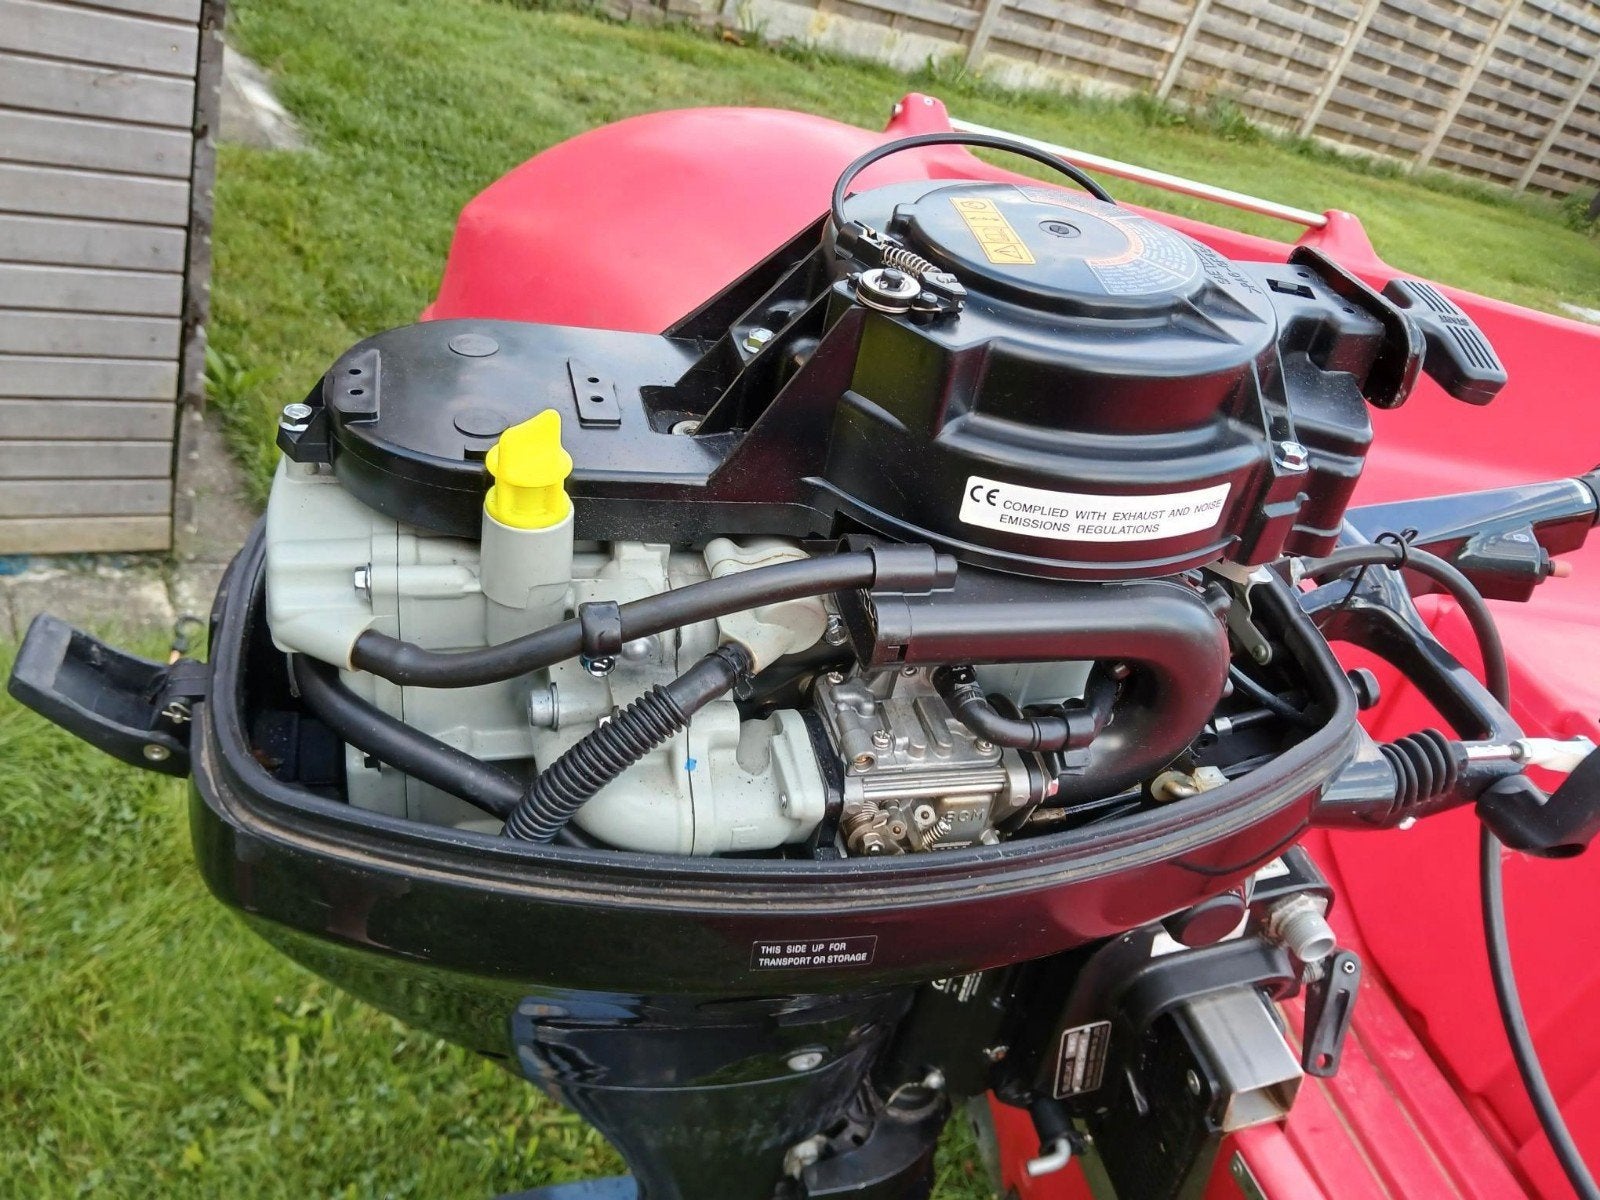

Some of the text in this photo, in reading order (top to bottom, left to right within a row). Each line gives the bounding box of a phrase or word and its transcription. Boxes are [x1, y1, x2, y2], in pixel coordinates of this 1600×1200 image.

[970, 485, 1000, 506] CE
[1003, 499, 1222, 521] COMPLIED WITH EXHAUST AND NOISE
[1000, 513, 1160, 535] EMISSIONS REGULATIONS
[761, 942, 847, 954] THIS SIDE UP FOR
[759, 952, 867, 966] TRANSPORT OR STORAGE
